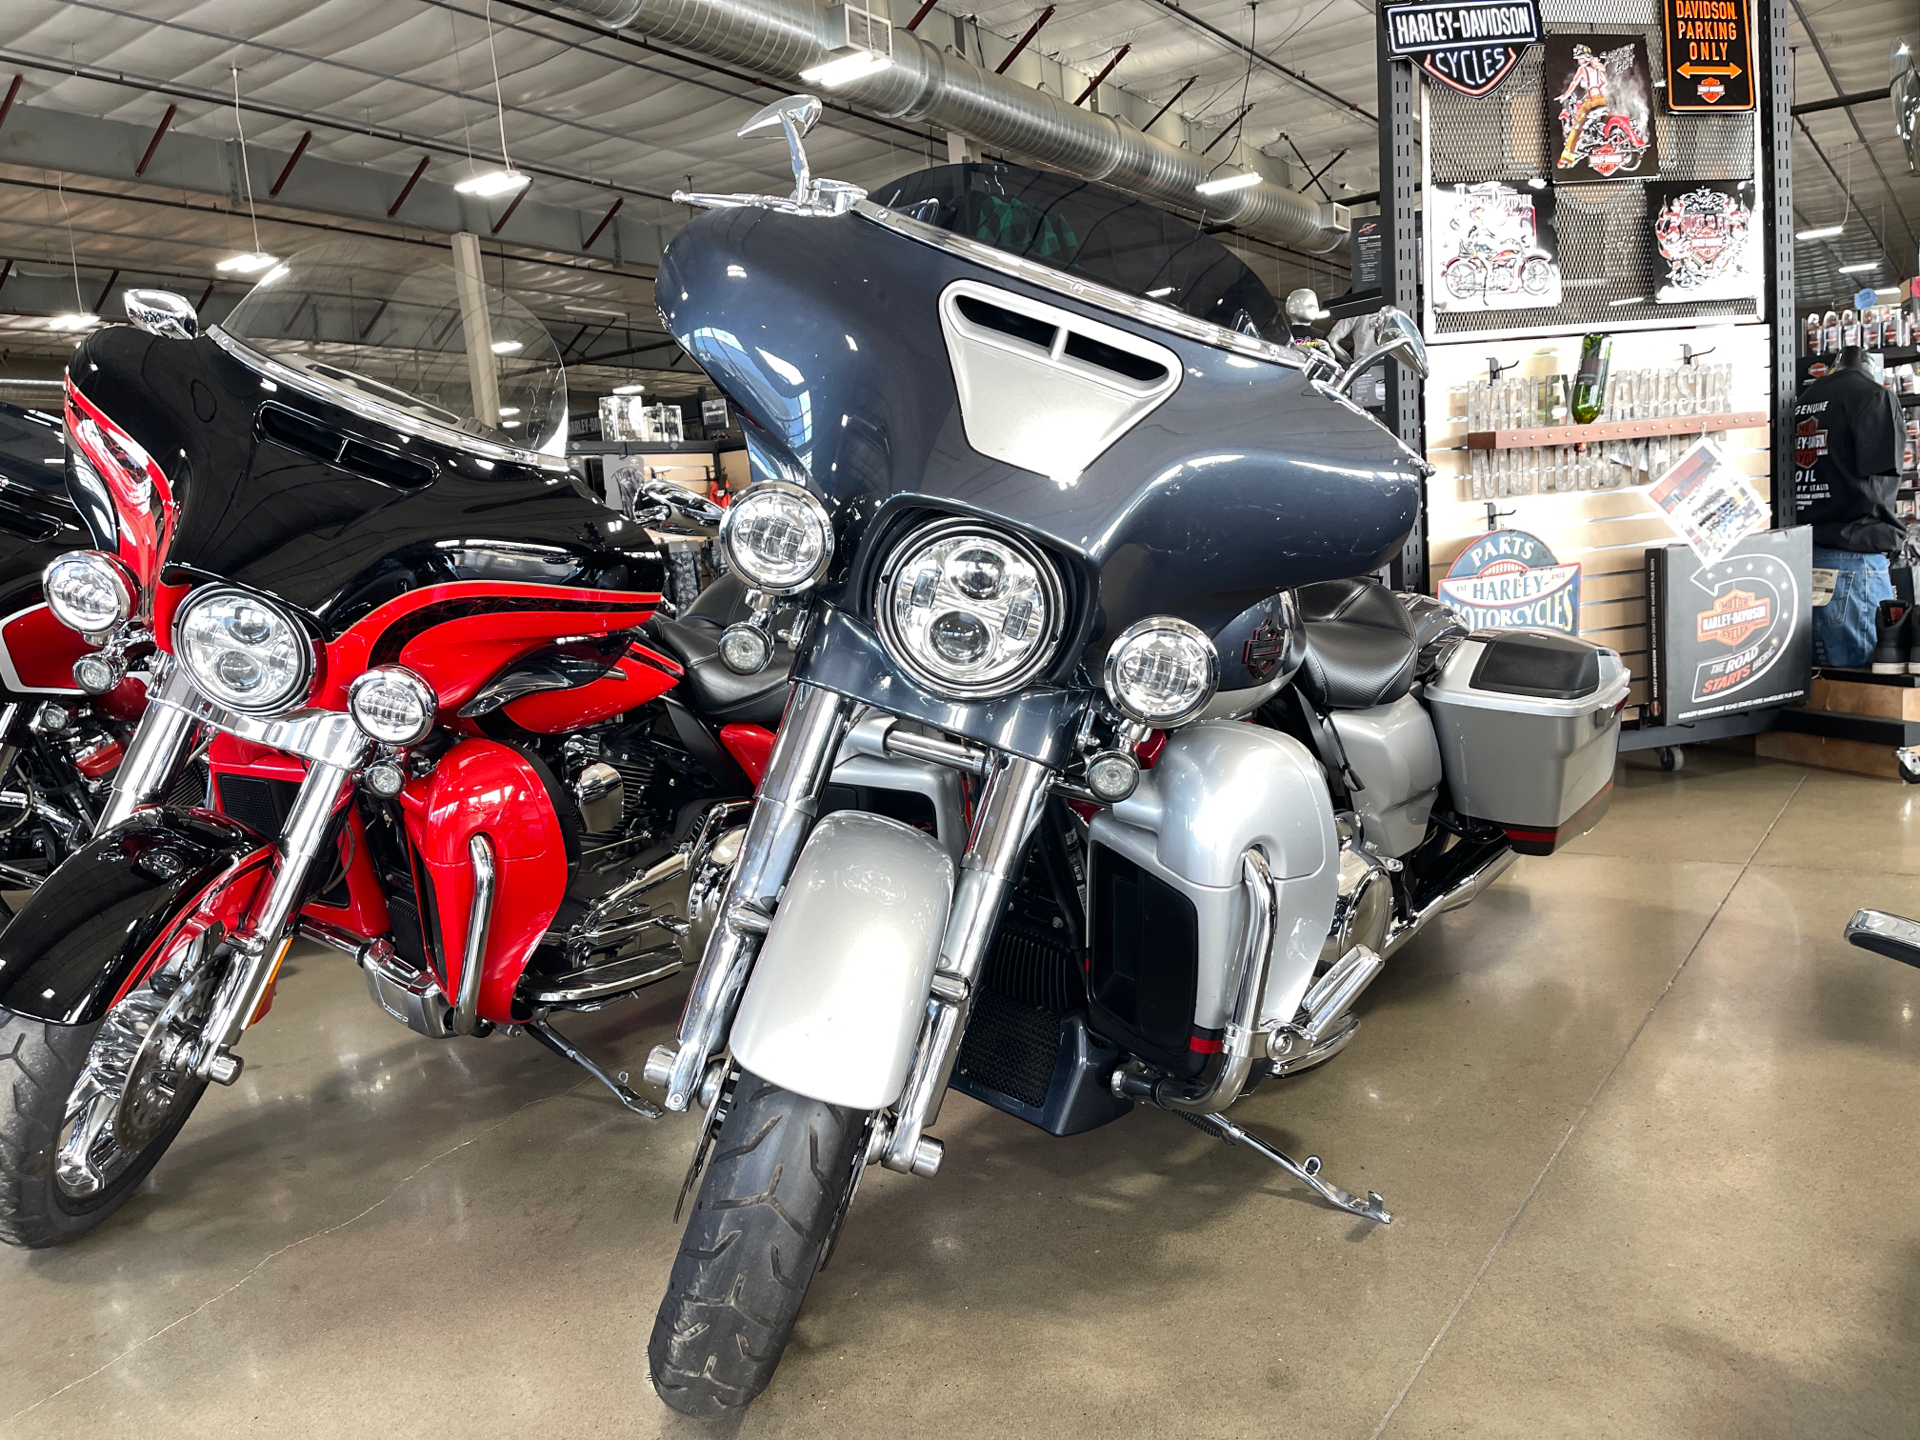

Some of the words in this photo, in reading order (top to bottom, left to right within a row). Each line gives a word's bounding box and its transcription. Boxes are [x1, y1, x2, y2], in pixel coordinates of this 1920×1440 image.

[1395, 7, 1531, 45] HARLEY-DAVIDSON
[1677, 20, 1737, 40] PARKING
[1689, 41, 1728, 60] ONLY
[1435, 48, 1505, 85] CYCLES
[1795, 401, 1828, 415] GENUINE
[1795, 470, 1816, 482] OIL
[1470, 536, 1535, 567] PARTS
[1473, 574, 1550, 601] HARLEY-
[1719, 596, 1750, 611] MOTOR
[1702, 605, 1767, 631] HARLEY-DAVIDSON
[1702, 664, 1751, 693] STARTS
[1752, 645, 1776, 671] HERE
[1710, 662, 1726, 675] THE
[1725, 646, 1760, 674] ROAD
